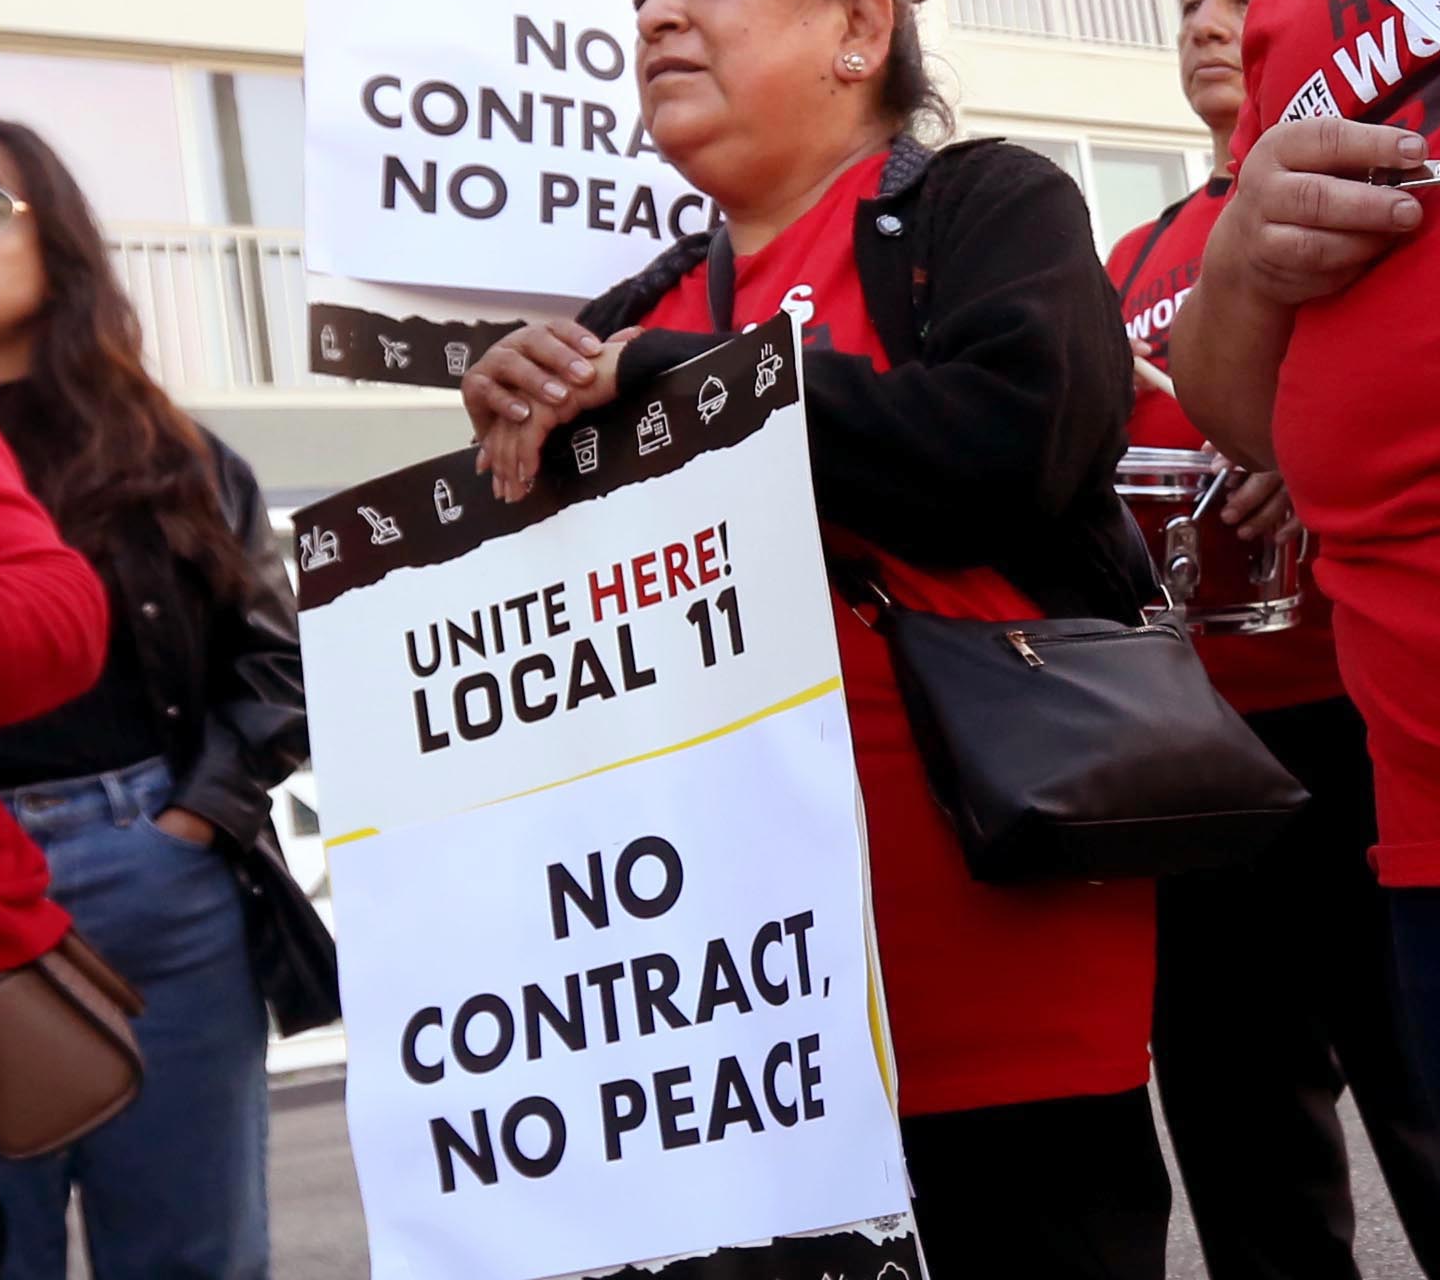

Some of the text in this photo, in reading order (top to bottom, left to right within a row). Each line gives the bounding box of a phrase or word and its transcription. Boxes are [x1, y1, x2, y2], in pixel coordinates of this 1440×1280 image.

[513, 14, 625, 81] NO
[1285, 75, 1327, 122] NITE
[381, 155, 508, 220] NO
[404, 521, 733, 678] UNITE HERE!
[412, 586, 746, 754] LOCAL 11
[547, 834, 685, 941] NO
[401, 909, 832, 1086] CONTRACT,
[429, 1032, 827, 1194] NO PEACE
